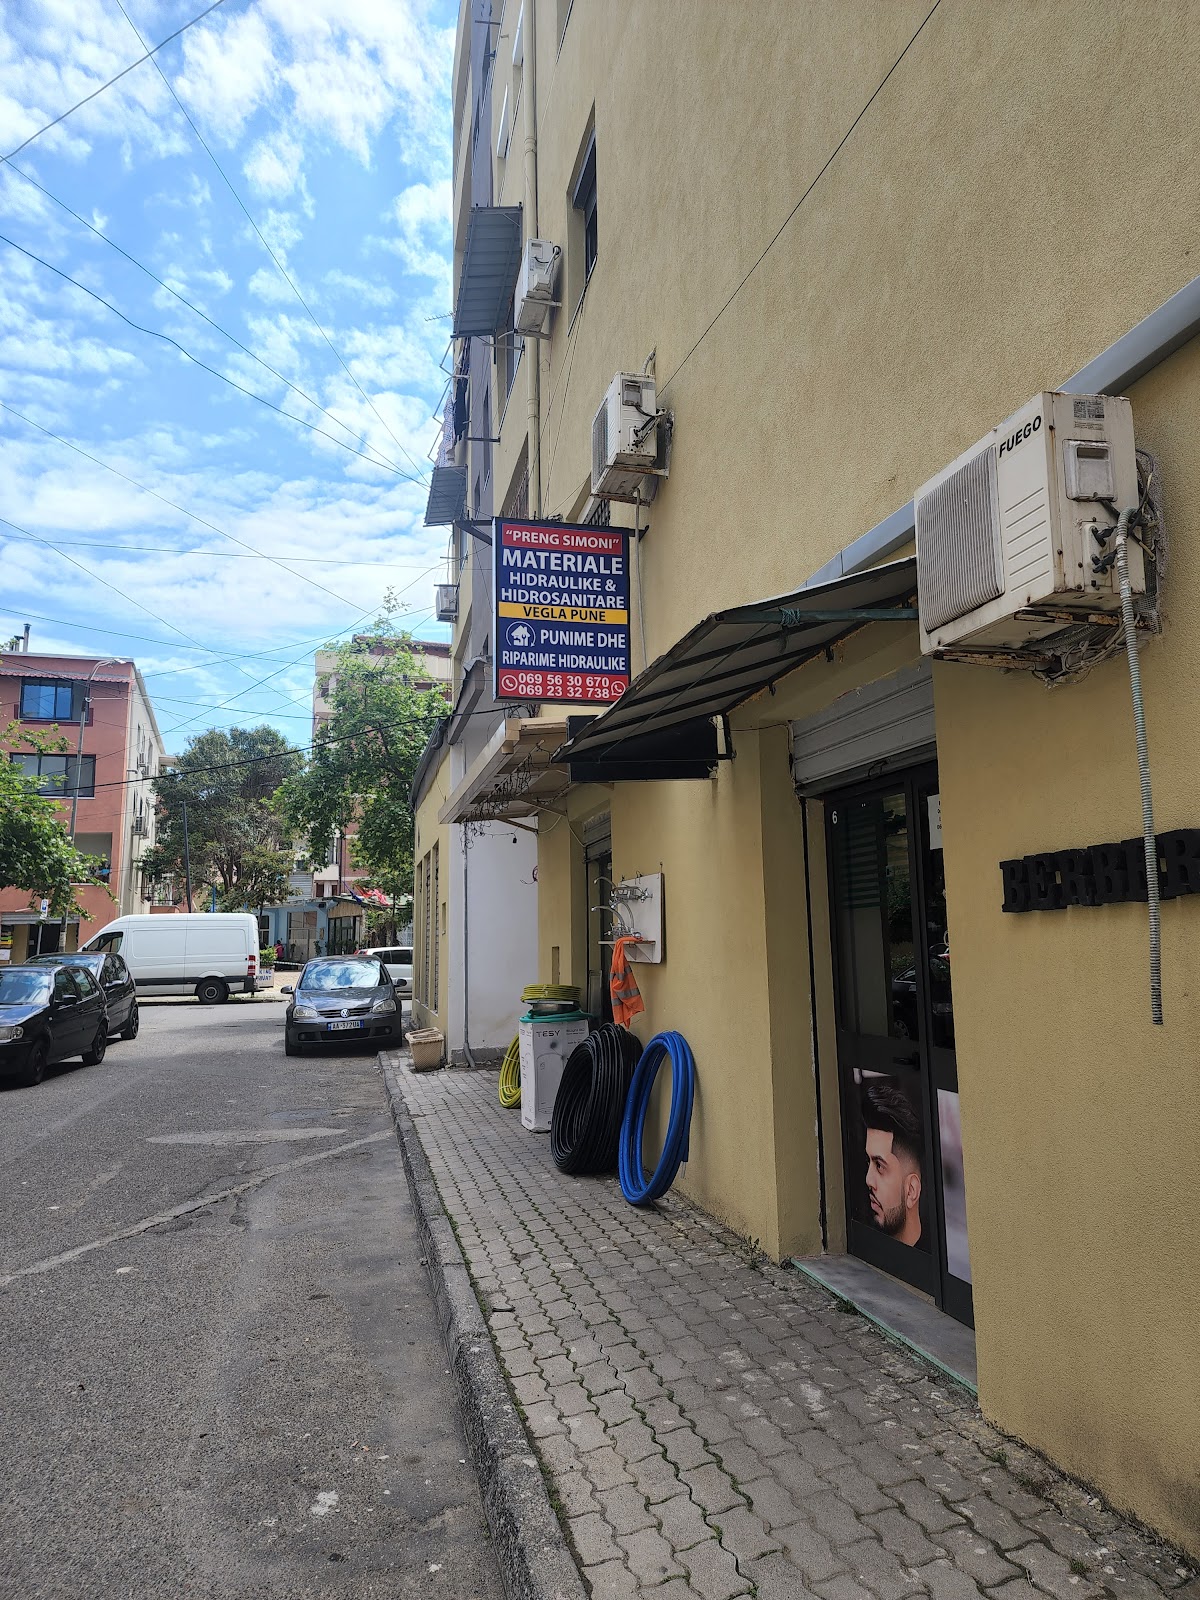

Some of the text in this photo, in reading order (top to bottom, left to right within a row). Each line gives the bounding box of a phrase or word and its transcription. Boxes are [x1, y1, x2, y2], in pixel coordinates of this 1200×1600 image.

[999, 415, 1042, 458] FUEGO
[502, 548, 623, 575] MATERIALE
[509, 571, 617, 592] HIDRAULIKE &
[501, 588, 625, 609] HIDROSANITARE
[523, 606, 606, 622] VEGLA PUNE
[540, 629, 626, 649] PUNIME DHE
[502, 650, 626, 671] RIPARIME HIDRAULIKE
[518, 673, 610, 688] 069 56 30 670
[518, 684, 610, 699] 069 23 32 738
[832, 810, 838, 824] 6
[535, 1030, 561, 1038] TESY
